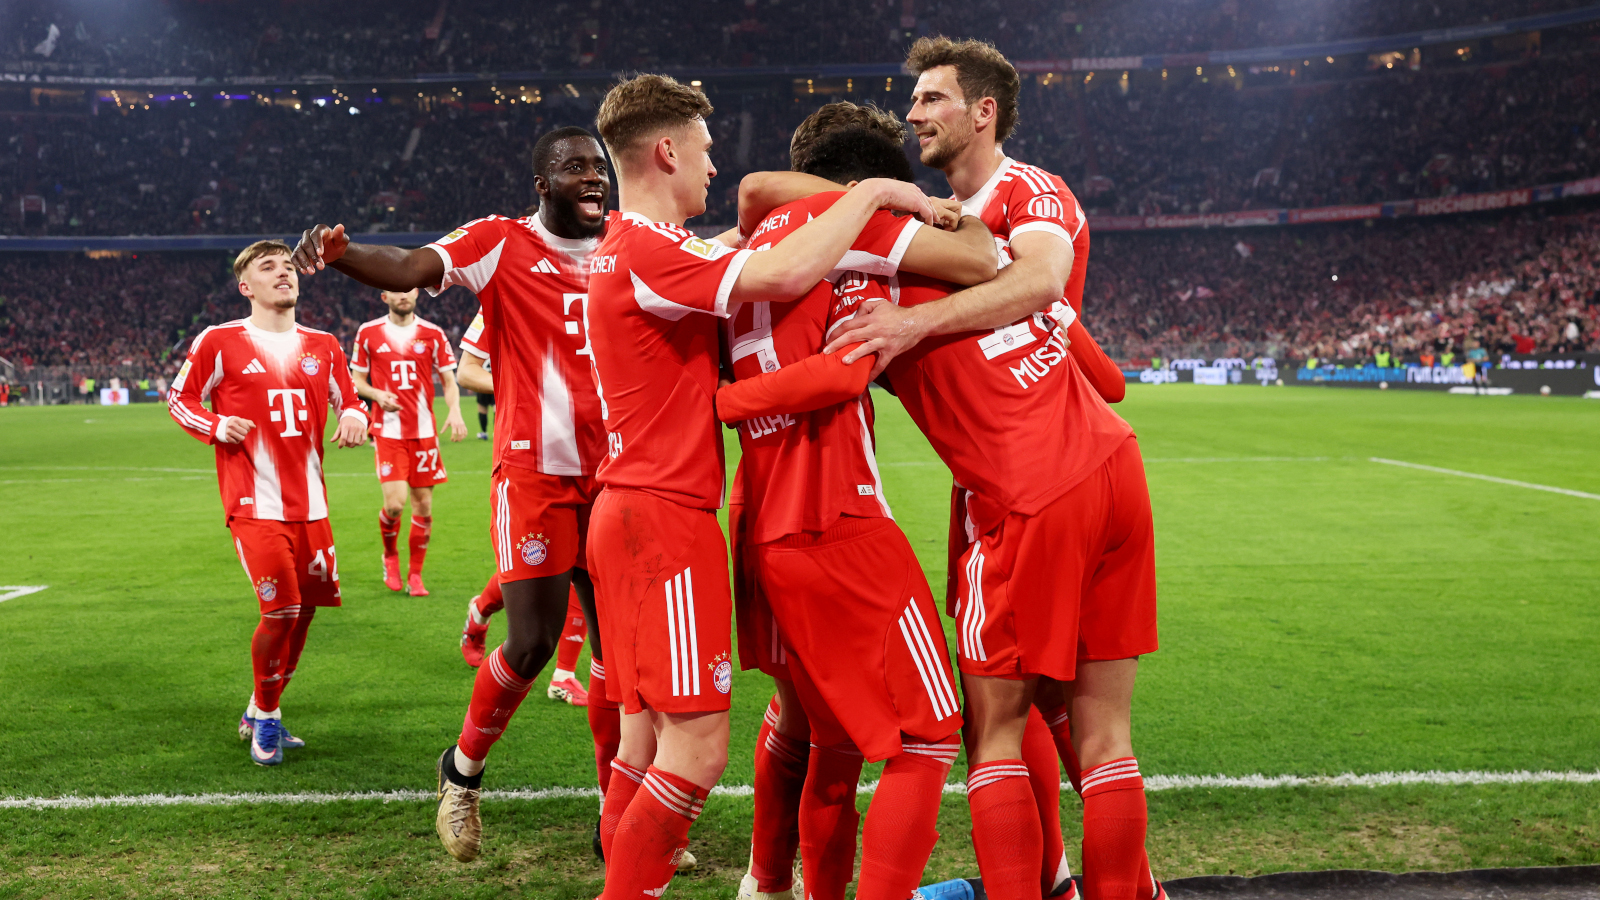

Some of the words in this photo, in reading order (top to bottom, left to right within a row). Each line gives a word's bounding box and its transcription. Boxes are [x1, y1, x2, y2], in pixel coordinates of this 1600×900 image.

[390, 360, 417, 390] T
[267, 389, 308, 437] T
[415, 448, 439, 472] 27
